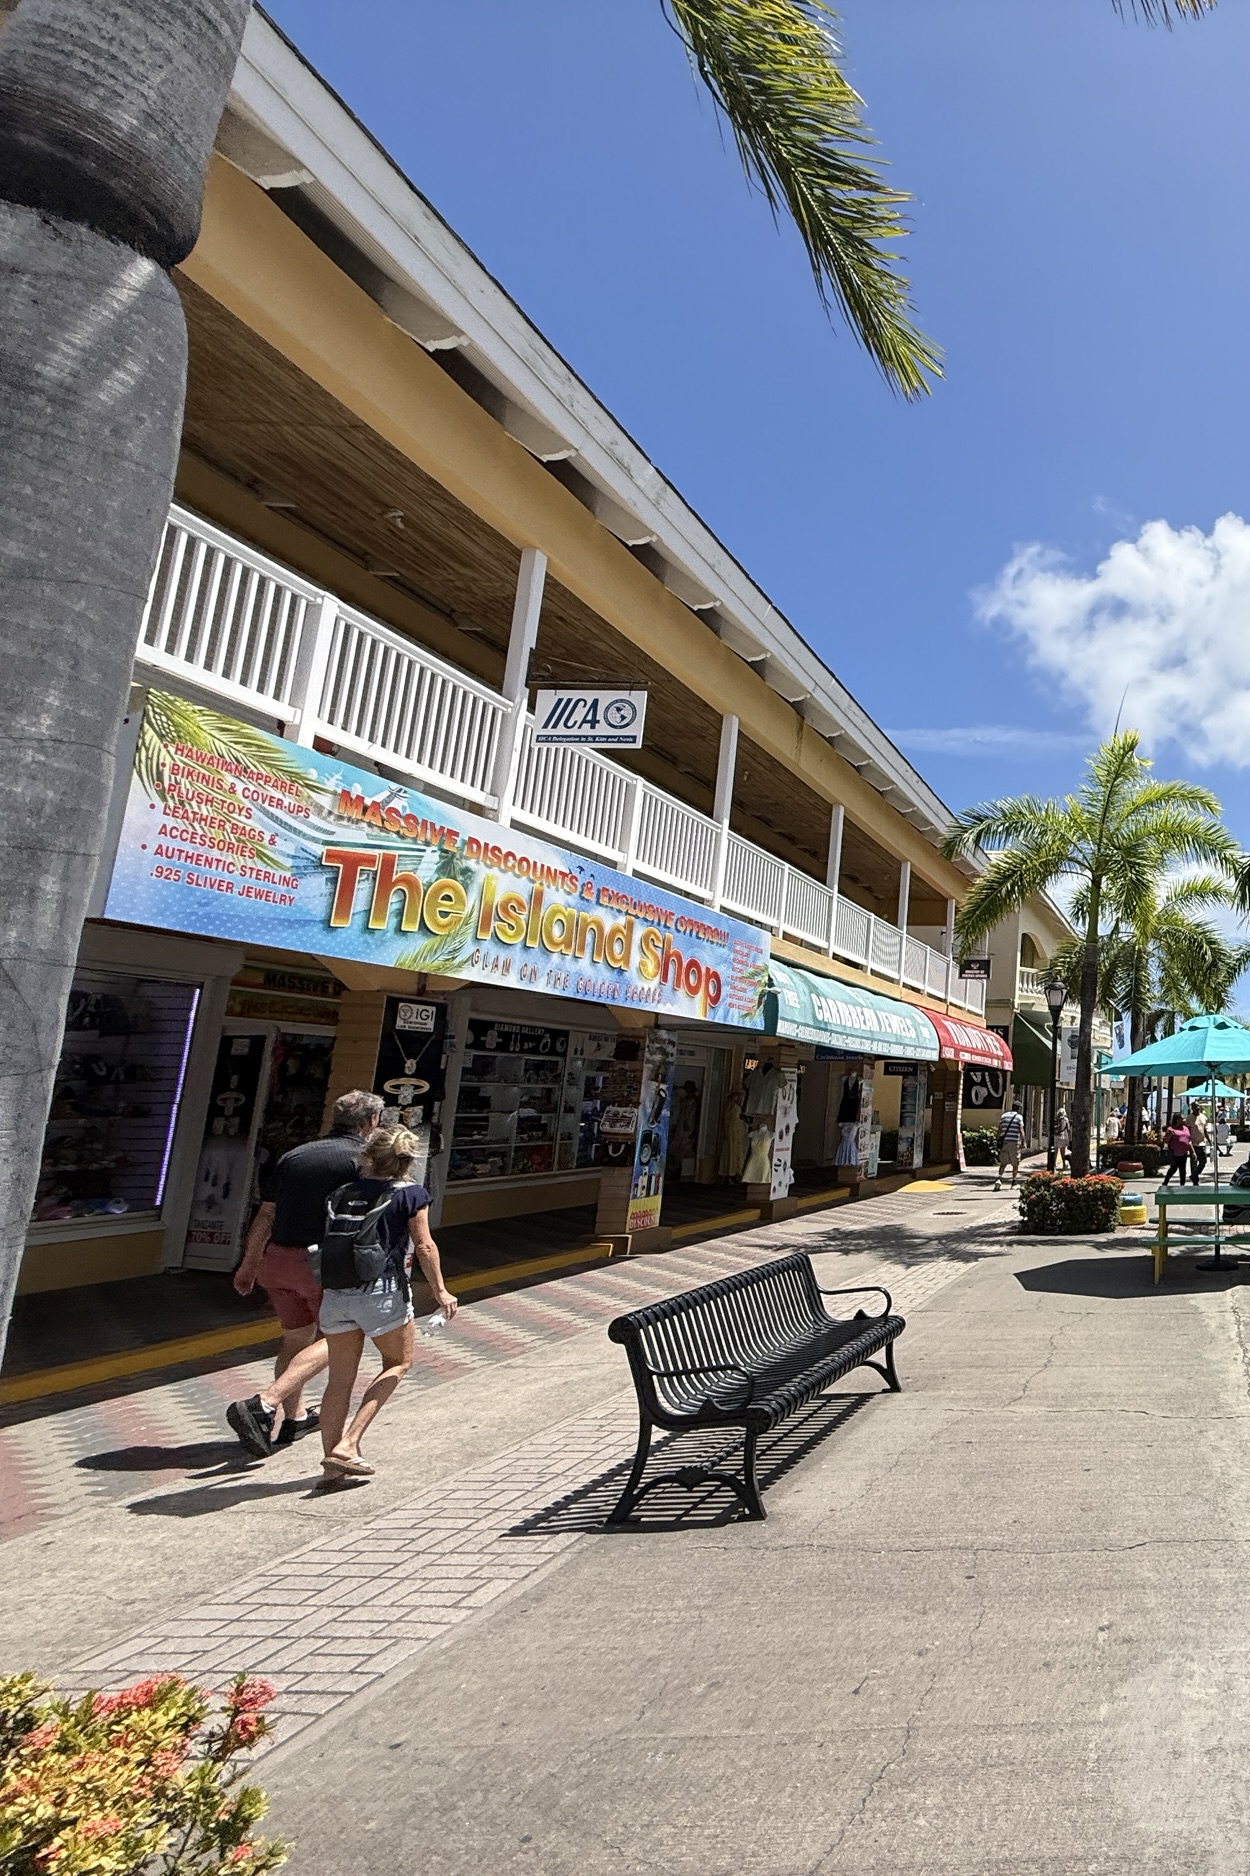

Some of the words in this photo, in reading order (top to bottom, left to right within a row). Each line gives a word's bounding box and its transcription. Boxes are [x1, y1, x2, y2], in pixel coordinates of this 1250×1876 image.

[541, 697, 600, 730] IICA
[170, 763, 225, 791] BIKINIS
[228, 782, 238, 795] &
[241, 786, 311, 819] COVER-UPS
[173, 743, 244, 777] HAWAIIAN
[247, 767, 302, 798] APPAREL
[166, 783, 215, 808] PLUSH
[219, 798, 254, 820] TOYS
[157, 823, 257, 860] ACCESSORIES
[162, 803, 227, 832] LEATHER
[230, 822, 265, 843] BAGS
[268, 832, 277, 846] &
[153, 843, 236, 875] AUTHENTIC
[239, 865, 299, 890] STERLING
[338, 789, 461, 852] MASSIVE
[465, 836, 579, 895] DISCOUNTS
[582, 880, 595, 900] &
[600, 886, 676, 927] EXCLUSIVE
[149, 865, 181, 883] .925
[186, 872, 235, 894] SLIVER
[237, 886, 295, 907] JEWELRY
[322, 846, 468, 936] The
[476, 872, 635, 971] Island
[639, 926, 722, 1019] Shop
[471, 947, 512, 976] GLAM
[520, 962, 538, 983] ON
[546, 969, 570, 991] THE
[811, 993, 879, 1032] CARIBBEAN
[877, 1010, 917, 1039] JEWELS
[888, 1065, 914, 1073] CITIZEN
